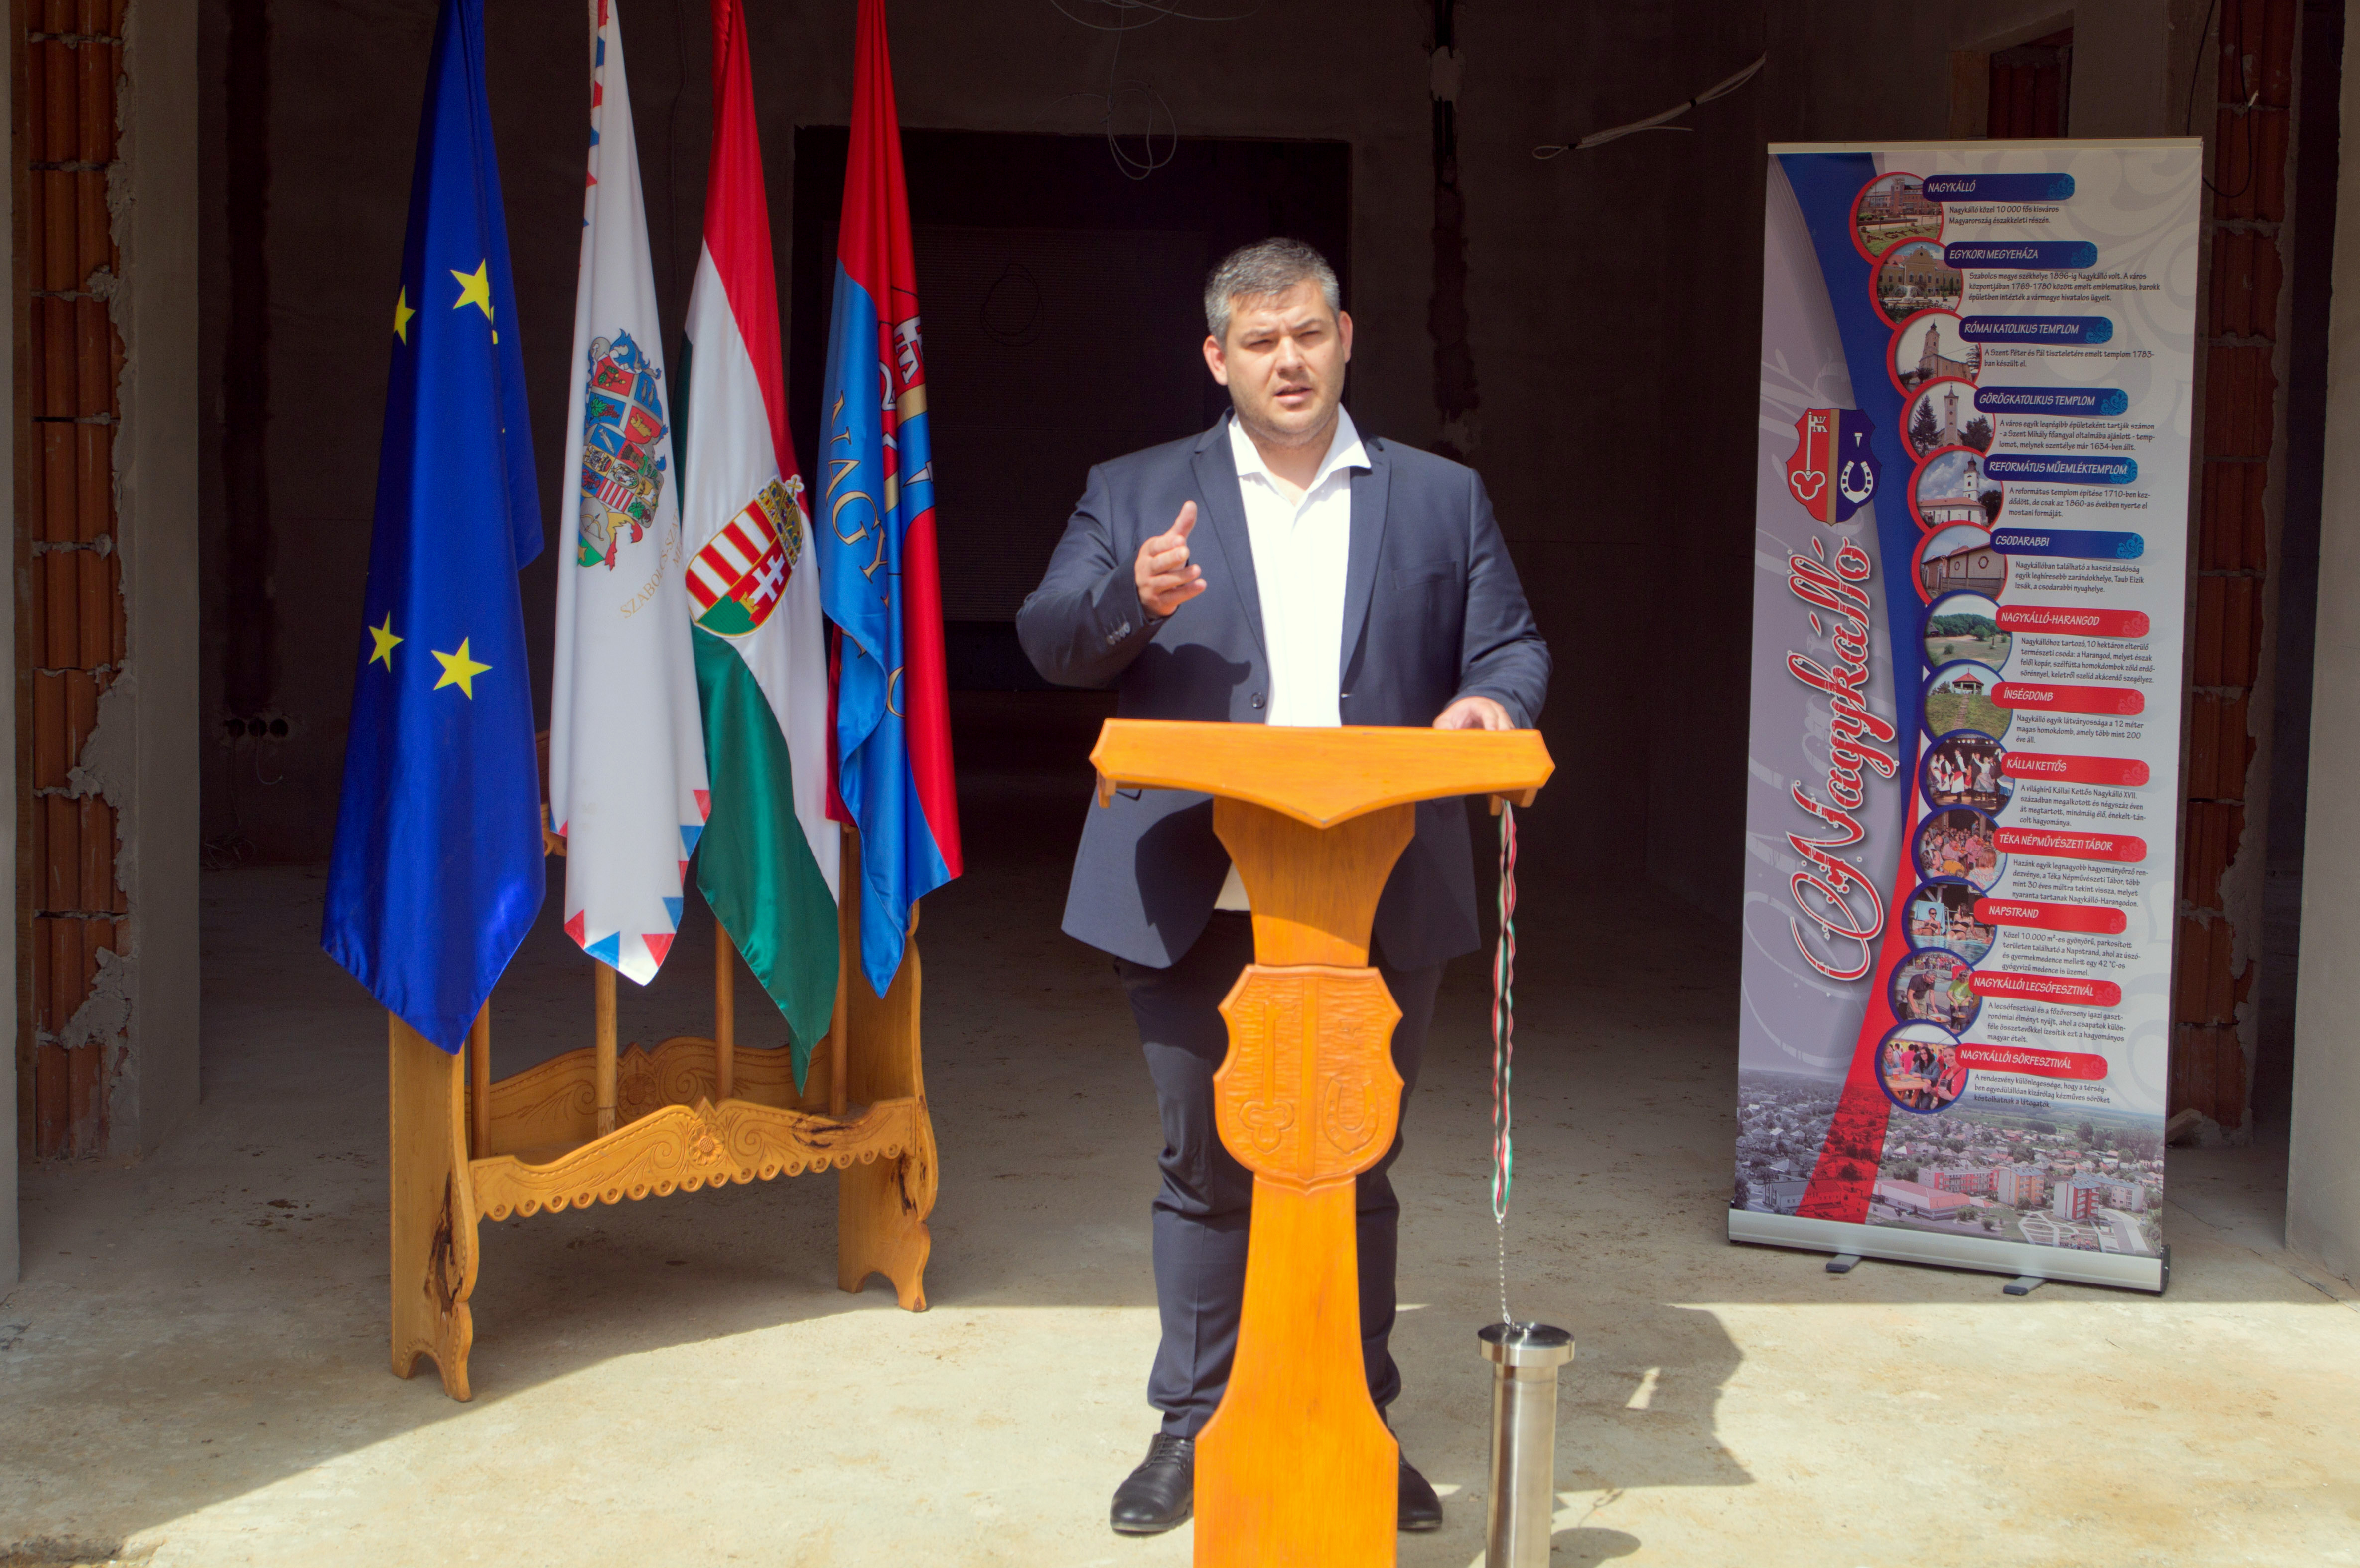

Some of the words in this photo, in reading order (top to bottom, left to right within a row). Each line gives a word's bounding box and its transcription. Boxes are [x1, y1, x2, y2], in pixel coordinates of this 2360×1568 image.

[1928, 181, 1976, 193] NAGYKÁLLÓ
[1949, 217, 1992, 226] Magyarország
[1949, 250, 1987, 259] EGYKORI
[1987, 247, 2039, 259] MEGYEHÁZA
[2018, 273, 2048, 281] székhelye
[2049, 273, 2077, 281] 1896-ig
[2078, 273, 2107, 281] Nagykálló
[1964, 321, 1992, 333] RÓMAI
[1992, 324, 2038, 333] KATOLIKUS
[2039, 325, 2080, 334] TEMPLOM
[2103, 350, 2131, 359] templom
[1979, 393, 2054, 405] GÖRÖGKATOLIKUS
[2055, 396, 2095, 406] TEMPLOM
[2039, 421, 2068, 429] legrégibb
[2069, 422, 2106, 430] épületeként
[1989, 460, 2046, 472] REFORMÁTUS
[2046, 461, 2128, 474] MŰEMLÉKTEMPLOM
[2079, 489, 2103, 498] építése
[2034, 510, 2063, 519] formáját.
[1995, 537, 2050, 547] CSODARABBI
[2015, 562, 2056, 570] Nagykállóban
[2112, 566, 2140, 574] zsidóság
[2031, 572, 2067, 581] leghíresebb
[2068, 574, 2113, 584] zarándokhelye,
[2073, 585, 2105, 594] nyughelye.
[2001, 611, 2100, 626] NAGYKÁLLÓ-HARANGOD
[2021, 638, 2060, 647] Nagykállóhoz
[2081, 651, 2112, 660] Harangod,
[2003, 687, 2054, 701] ÍNSÉGDOMB
[2016, 715, 2046, 723] Nagykálló
[2063, 717, 2109, 727] látványossága
[2037, 727, 2075, 736] homokdomb,
[2076, 729, 2094, 738] amely
[2006, 757, 2035, 770] KÁLLAI
[2035, 760, 2067, 772] KETTŐS
[2100, 801, 2129, 810] négyszáz
[2032, 817, 2072, 827] hagyománya.
[1999, 832, 2020, 844] TÉKA
[2021, 833, 2083, 849] NÉPMŰVÉSZETI
[2085, 838, 2113, 851] TÁBOR
[2117, 889, 2138, 897] melyet
[1988, 906, 2039, 918] NAPSTRAND
[2066, 947, 2101, 957] Napstrand,
[1973, 977, 2025, 990] NAGYKÁLLÓI
[2025, 981, 2094, 996] LECSÓFESZTIVÁL
[2015, 1015, 2040, 1025] élményt
[1960, 1050, 2012, 1063] NAGYKÁLLÓI
[2012, 1054, 2072, 1069] SÖRFESZTIVÁL
[1980, 1075, 2015, 1085] rendezvény
[2015, 1077, 2062, 1089] különlegessége,
[2063, 1081, 2078, 1091] hogy
[2083, 1083, 2107, 1093] térség-
[1974, 1095, 2015, 1104] kóstolhatnak
[2020, 1099, 2052, 1108] látogatók.
